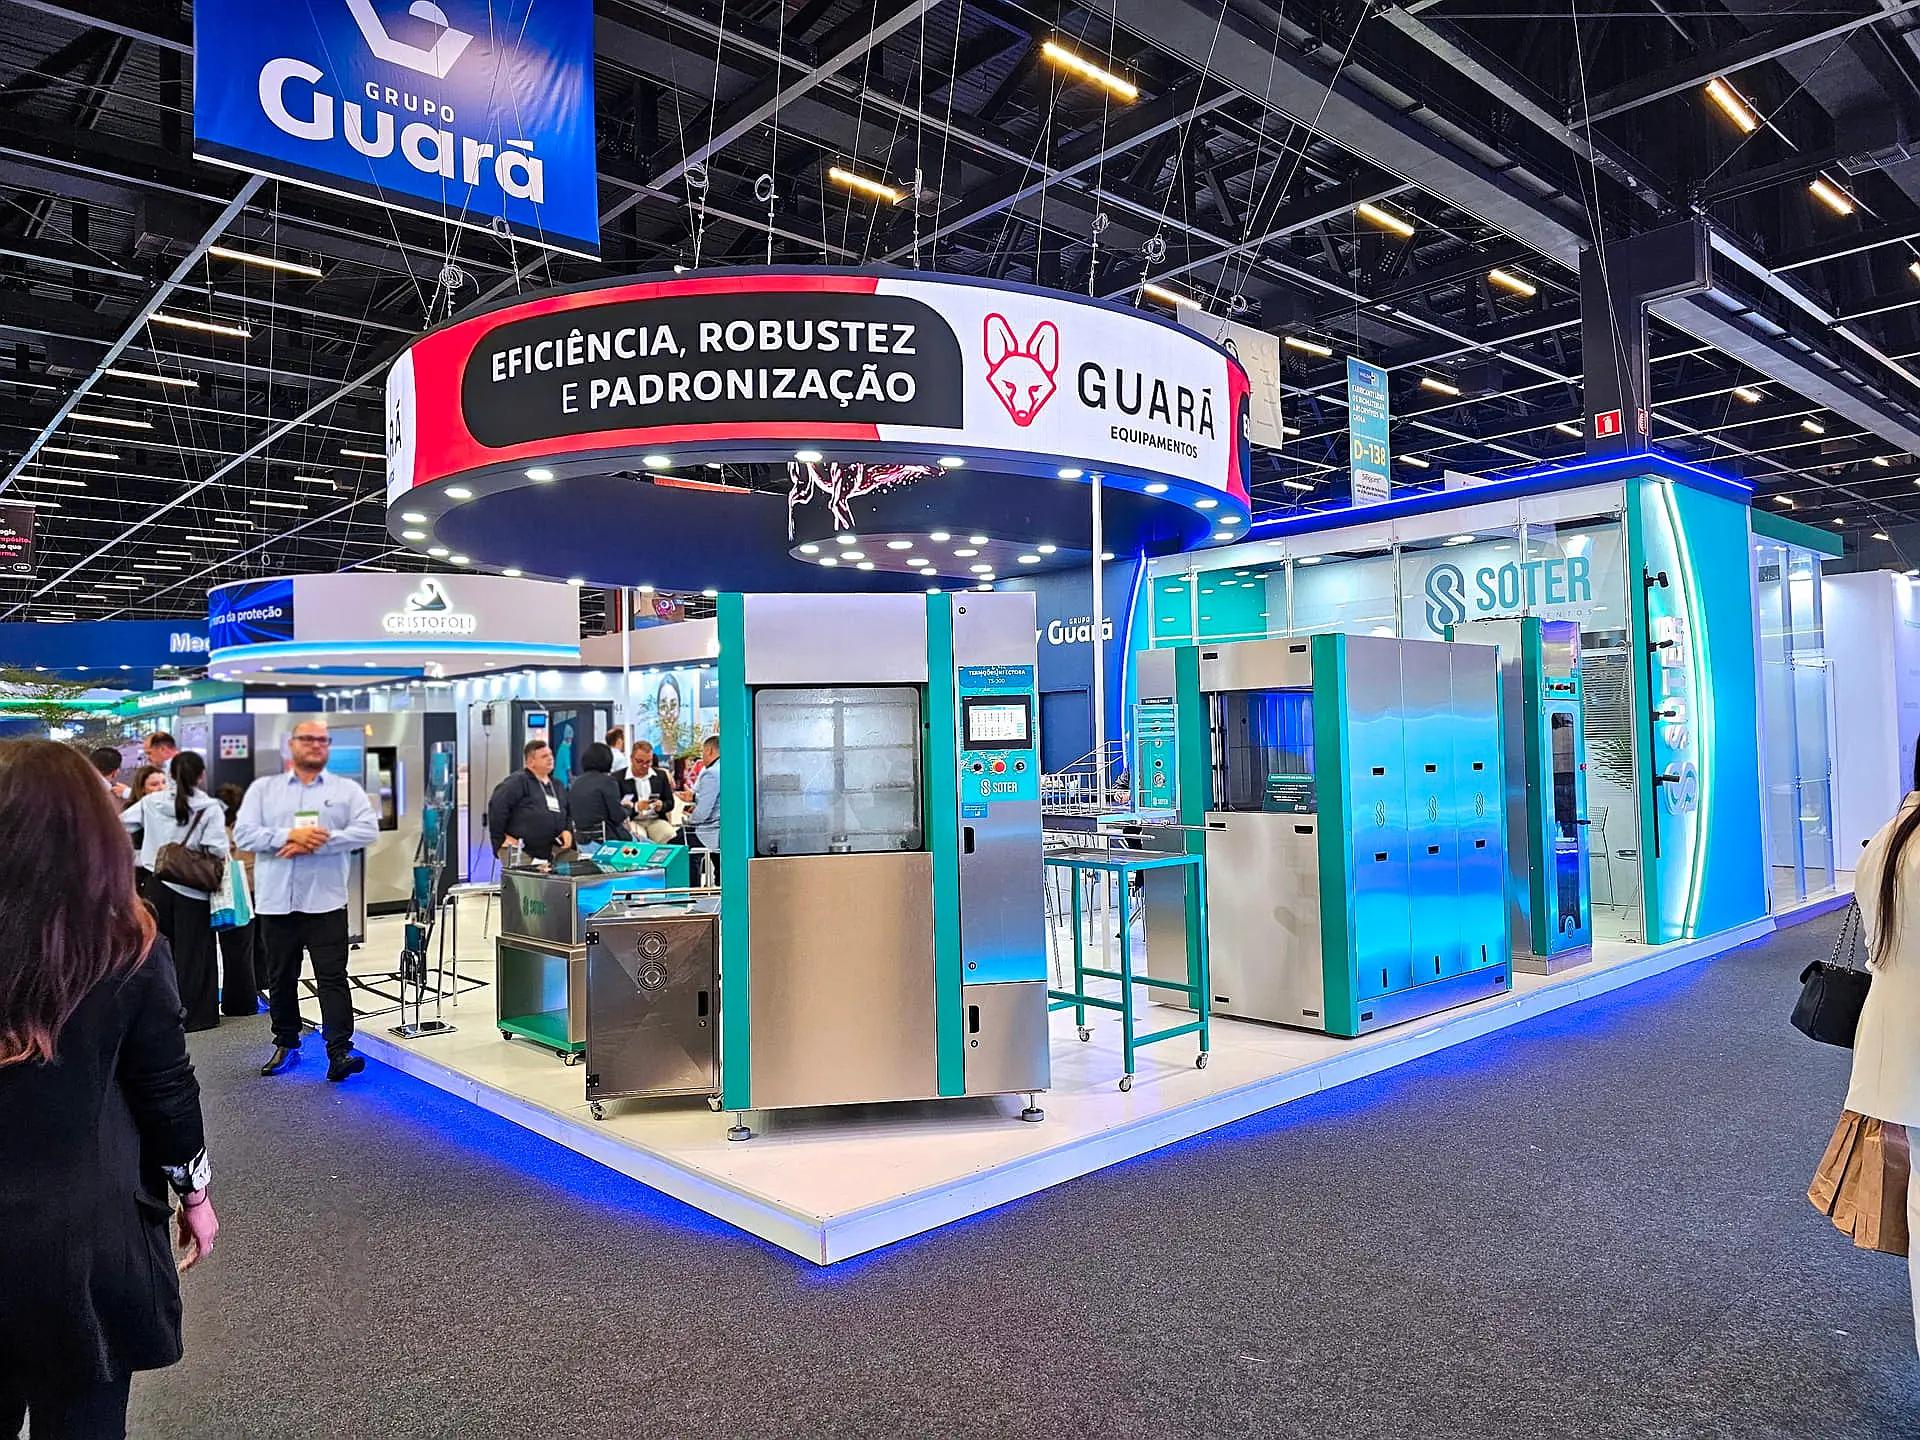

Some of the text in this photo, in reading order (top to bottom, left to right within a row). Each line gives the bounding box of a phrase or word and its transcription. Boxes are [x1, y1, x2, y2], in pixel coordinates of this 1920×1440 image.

[365, 81, 455, 123] GRUPO
[259, 56, 544, 204] Guará
[491, 320, 916, 383] EFICIÊNCIA, ROBUSTEZ
[561, 364, 916, 414] E PADRONIZAÇÃO
[1078, 361, 1215, 440] GUARÁ
[1111, 426, 1198, 459] EQUIPAMENTOS
[1353, 439, 1386, 467] D-138
[226, 611, 236, 623] da
[237, 605, 283, 623] proteção
[1068, 616, 1090, 625] GRUPO
